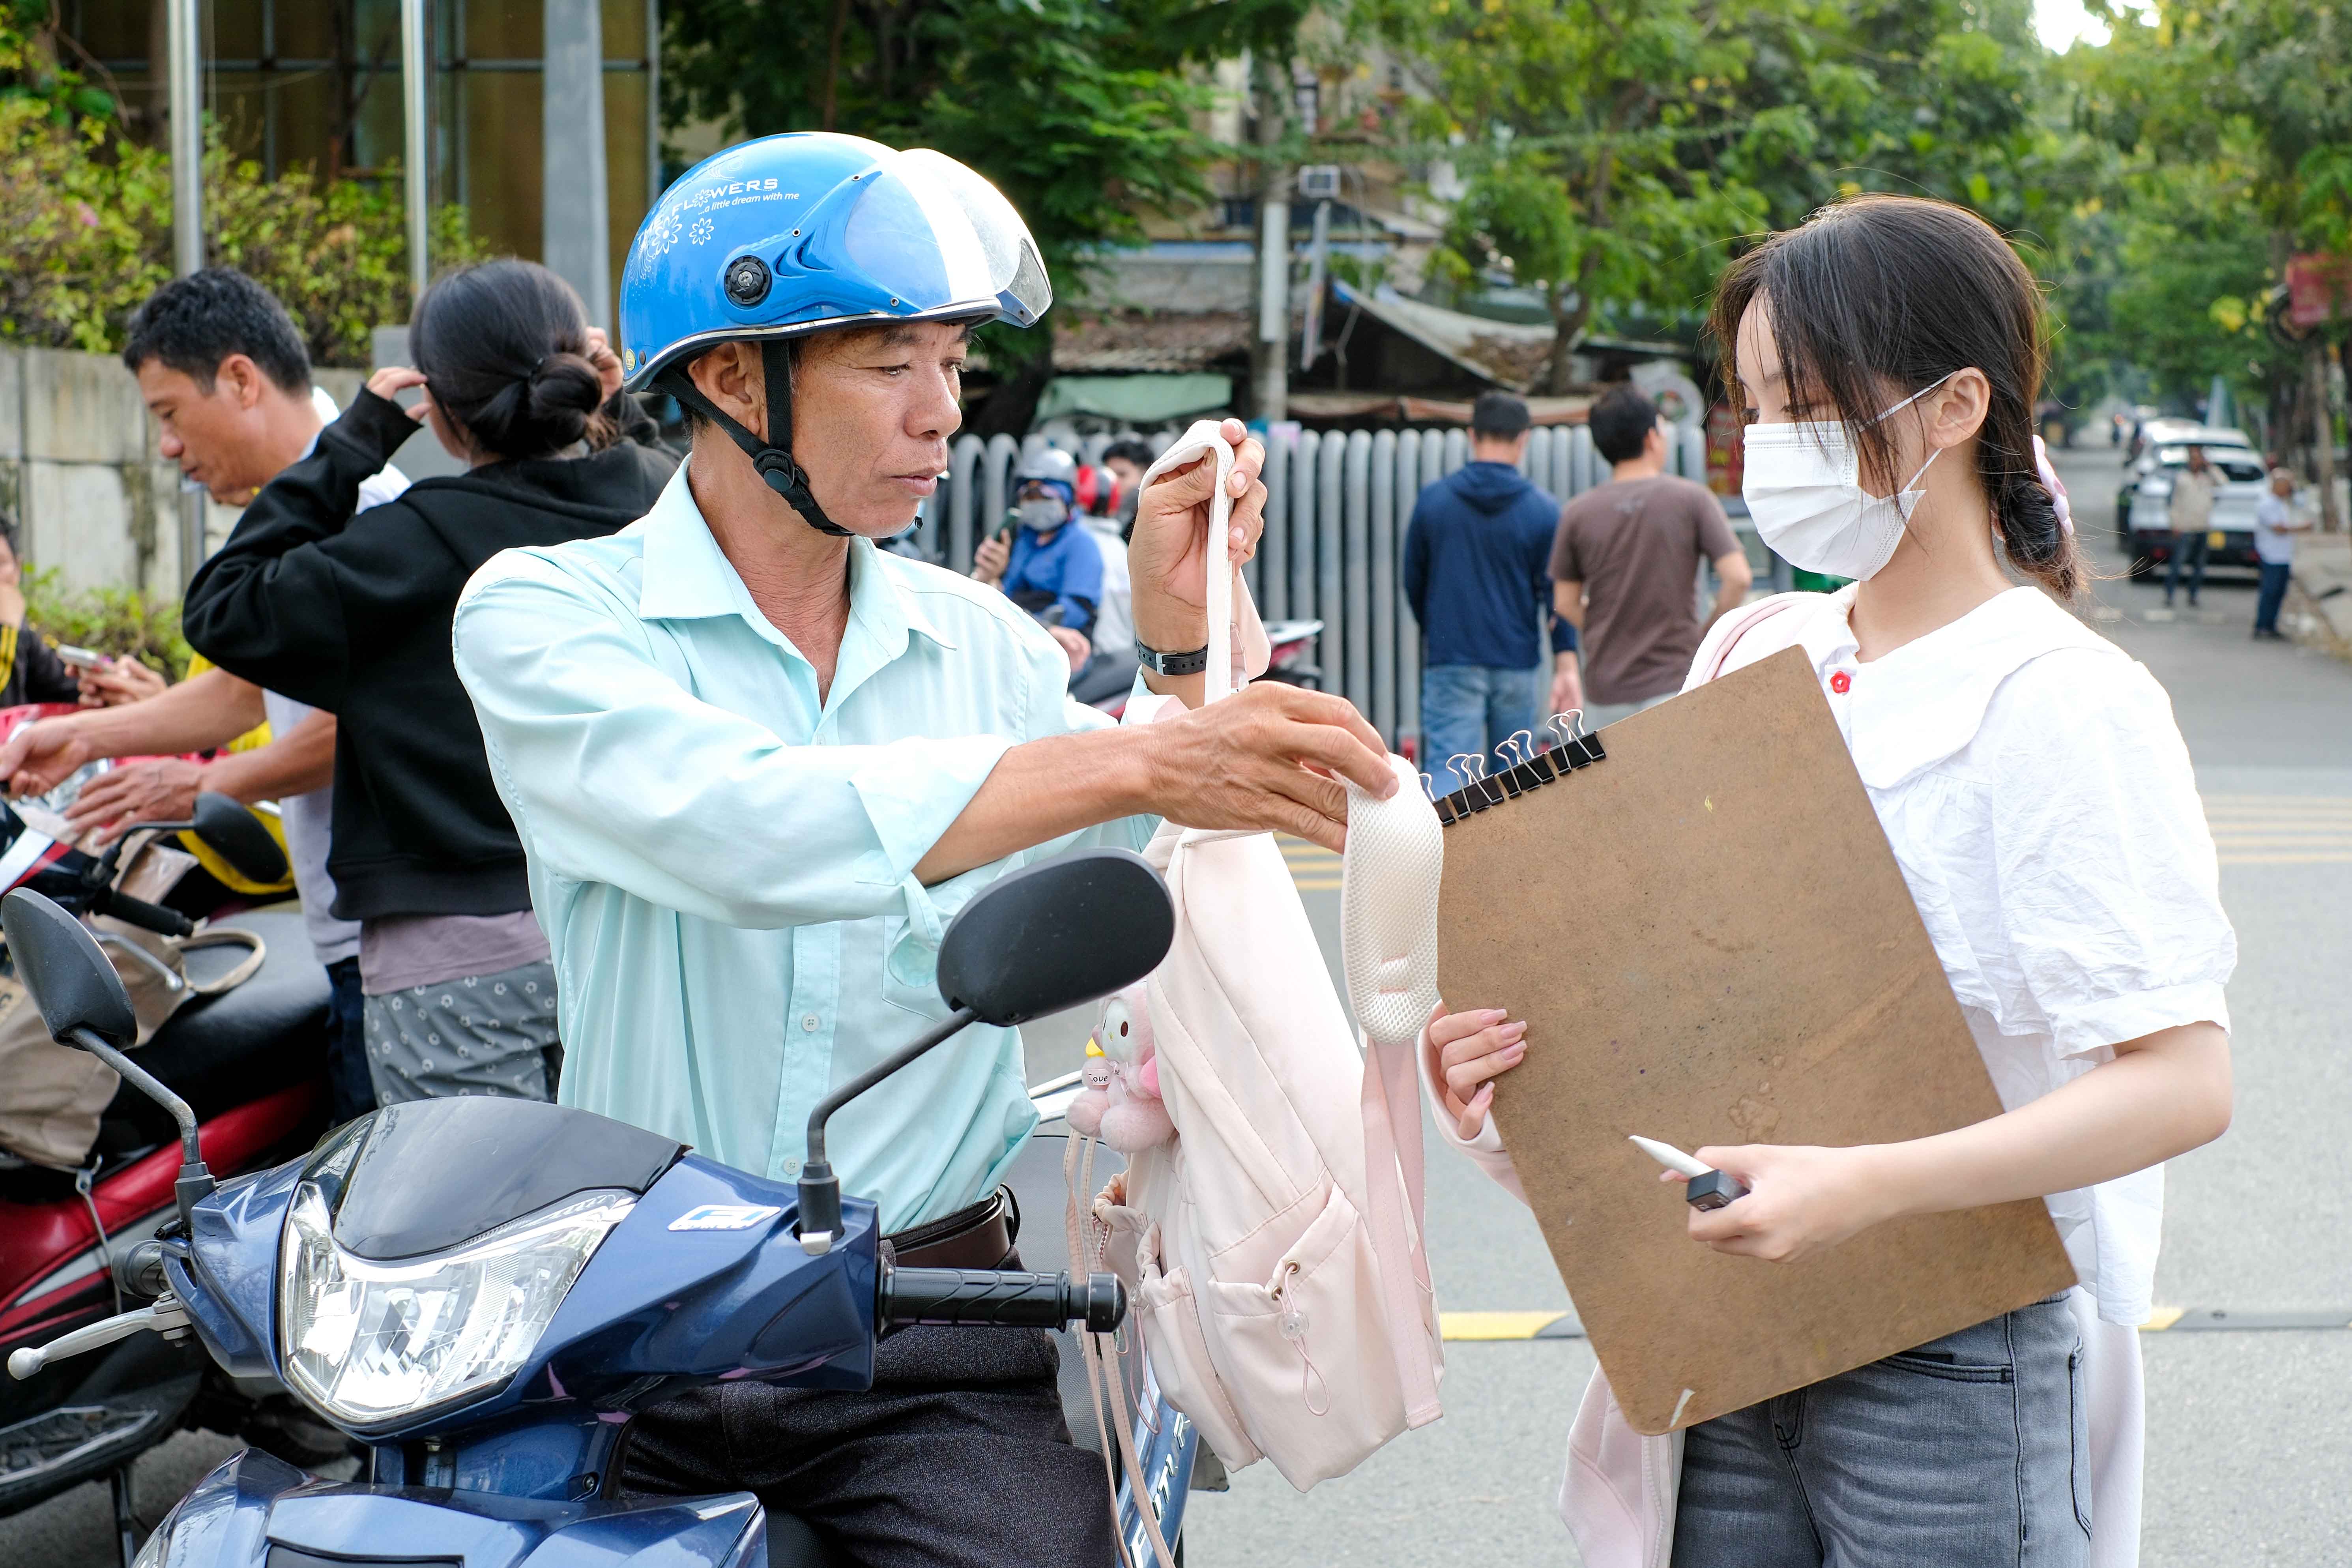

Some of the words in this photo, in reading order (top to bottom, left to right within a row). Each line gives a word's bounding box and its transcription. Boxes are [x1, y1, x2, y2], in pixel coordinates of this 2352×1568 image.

[711, 199, 730, 211] little
[732, 195, 760, 206] dream
[763, 192, 782, 201] with
[1089, 1073, 1108, 1082] ove
